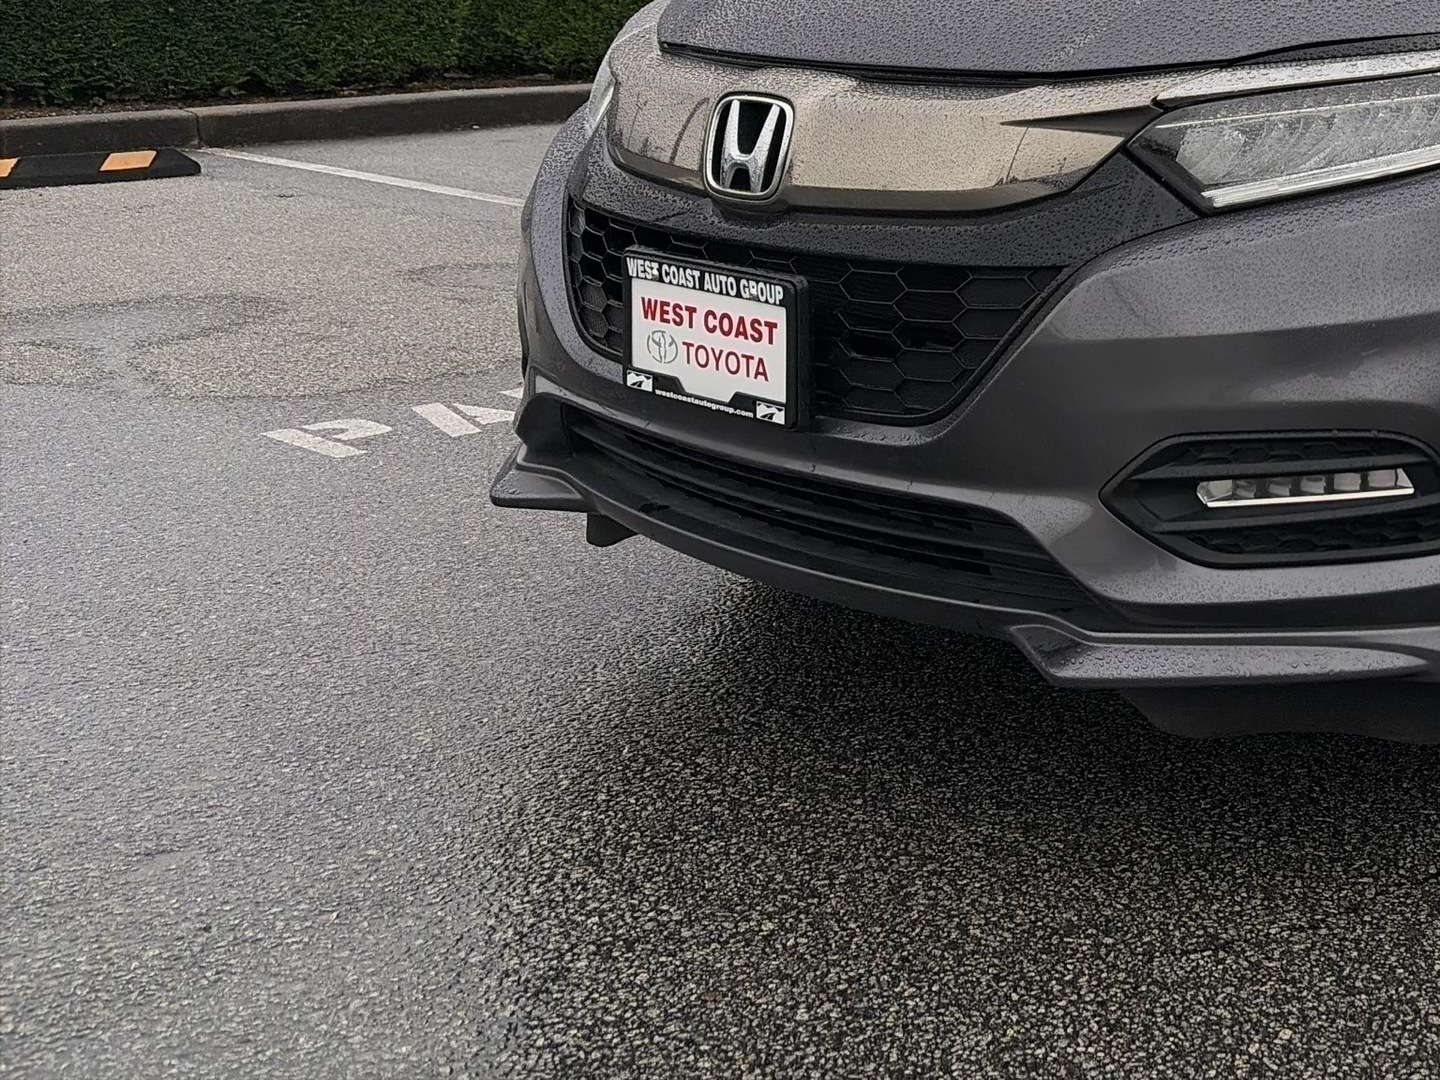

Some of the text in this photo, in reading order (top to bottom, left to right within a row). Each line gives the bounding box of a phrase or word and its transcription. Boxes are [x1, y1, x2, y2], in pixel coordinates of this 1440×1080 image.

[626, 257, 784, 306] WEST COAST AUTO GROUP
[640, 296, 778, 345] WEST COAST
[681, 341, 770, 383] TOYOTA
[654, 388, 755, 419] westcoastautogroup.com
